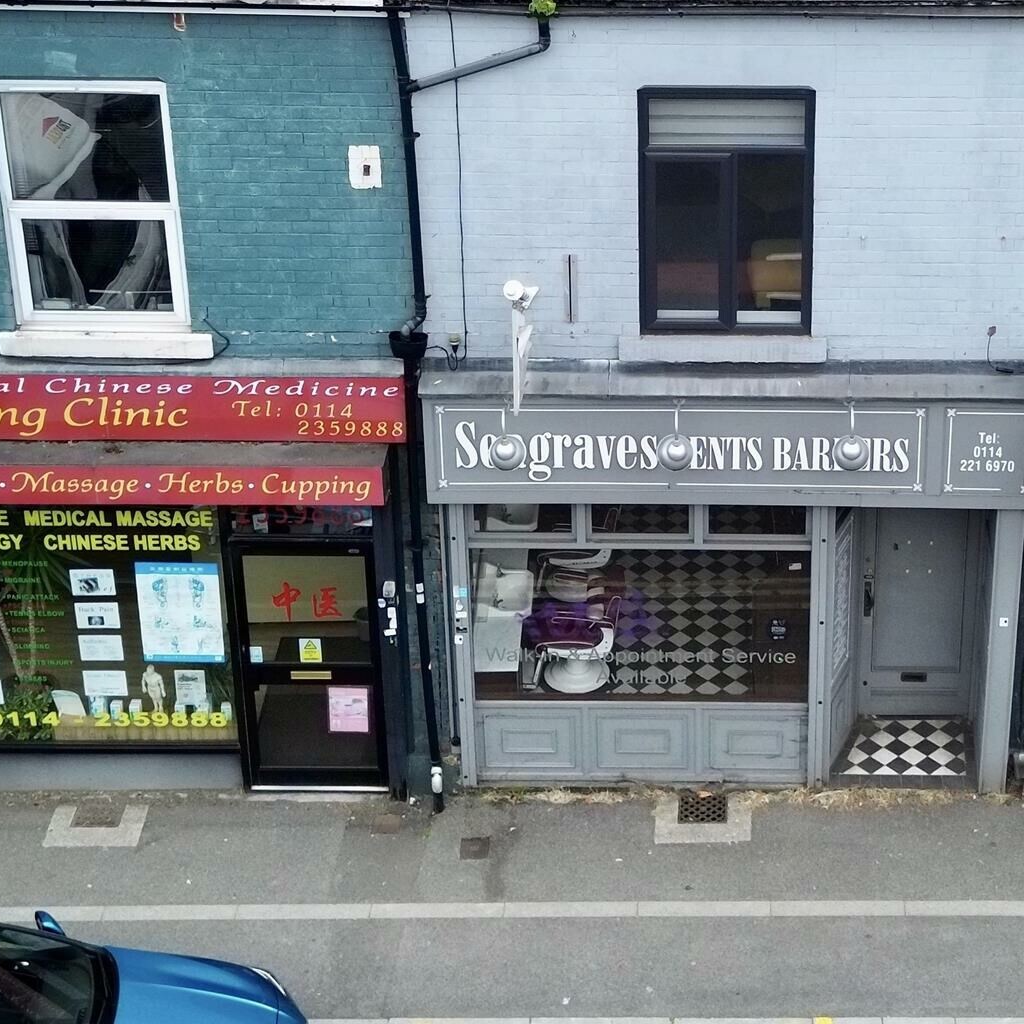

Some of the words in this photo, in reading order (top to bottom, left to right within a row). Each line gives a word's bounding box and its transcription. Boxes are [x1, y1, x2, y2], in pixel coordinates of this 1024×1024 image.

[45, 377, 193, 394] Chinese
[213, 379, 399, 397] Medicine
[63, 396, 190, 428] Clinic
[231, 400, 282, 418] Tel:
[295, 402, 353, 418] 0114
[297, 420, 403, 437] 2359888
[978, 431, 1000, 444] Tel:
[454, 421, 659, 481] Segraves
[670, 436, 763, 473] ENTS
[772, 436, 910, 473] BARRS
[973, 445, 1003, 458] 0114
[959, 459, 981, 472] 221
[985, 460, 1015, 473] 6970
[11, 471, 139, 500] Massage
[158, 472, 244, 494] Herbs
[261, 473, 371, 501] Cupping
[23, 509, 112, 527] MEDICAL
[116, 510, 214, 527] MASSAGE
[43, 533, 128, 551] CHINESE
[134, 534, 201, 551] HERBS
[272, 581, 343, 621] 中医
[486, 647, 560, 663] Walk-in
[587, 647, 714, 666] Appointment
[721, 647, 796, 664] Service
[596, 668, 687, 685] Available
[94, 711, 227, 728] 2359888
